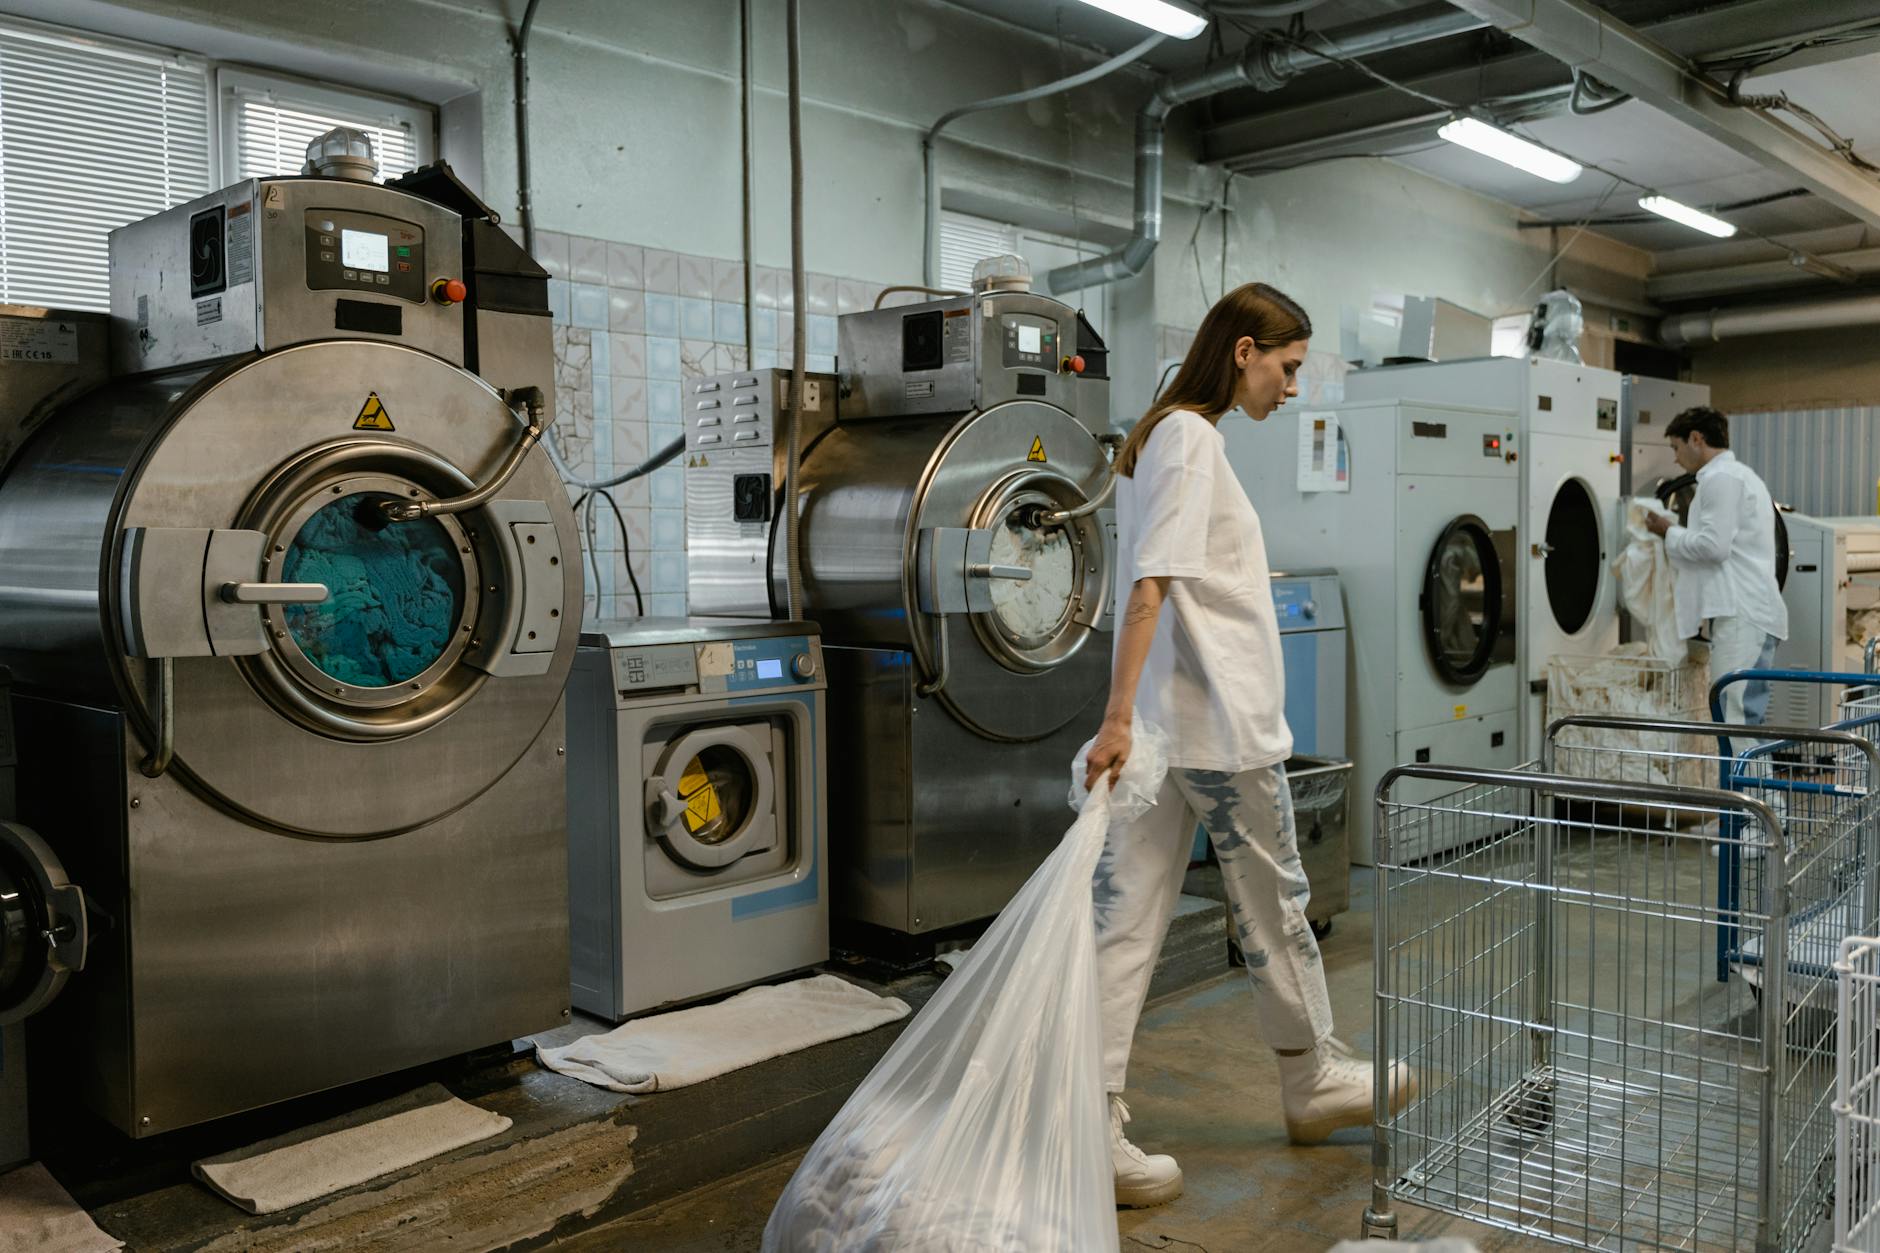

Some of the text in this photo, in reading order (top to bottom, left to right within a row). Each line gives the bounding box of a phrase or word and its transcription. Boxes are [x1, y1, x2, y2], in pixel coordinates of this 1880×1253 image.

[270, 188, 280, 202] 2
[25, 350, 39, 359] CE
[706, 651, 715, 664] 1
